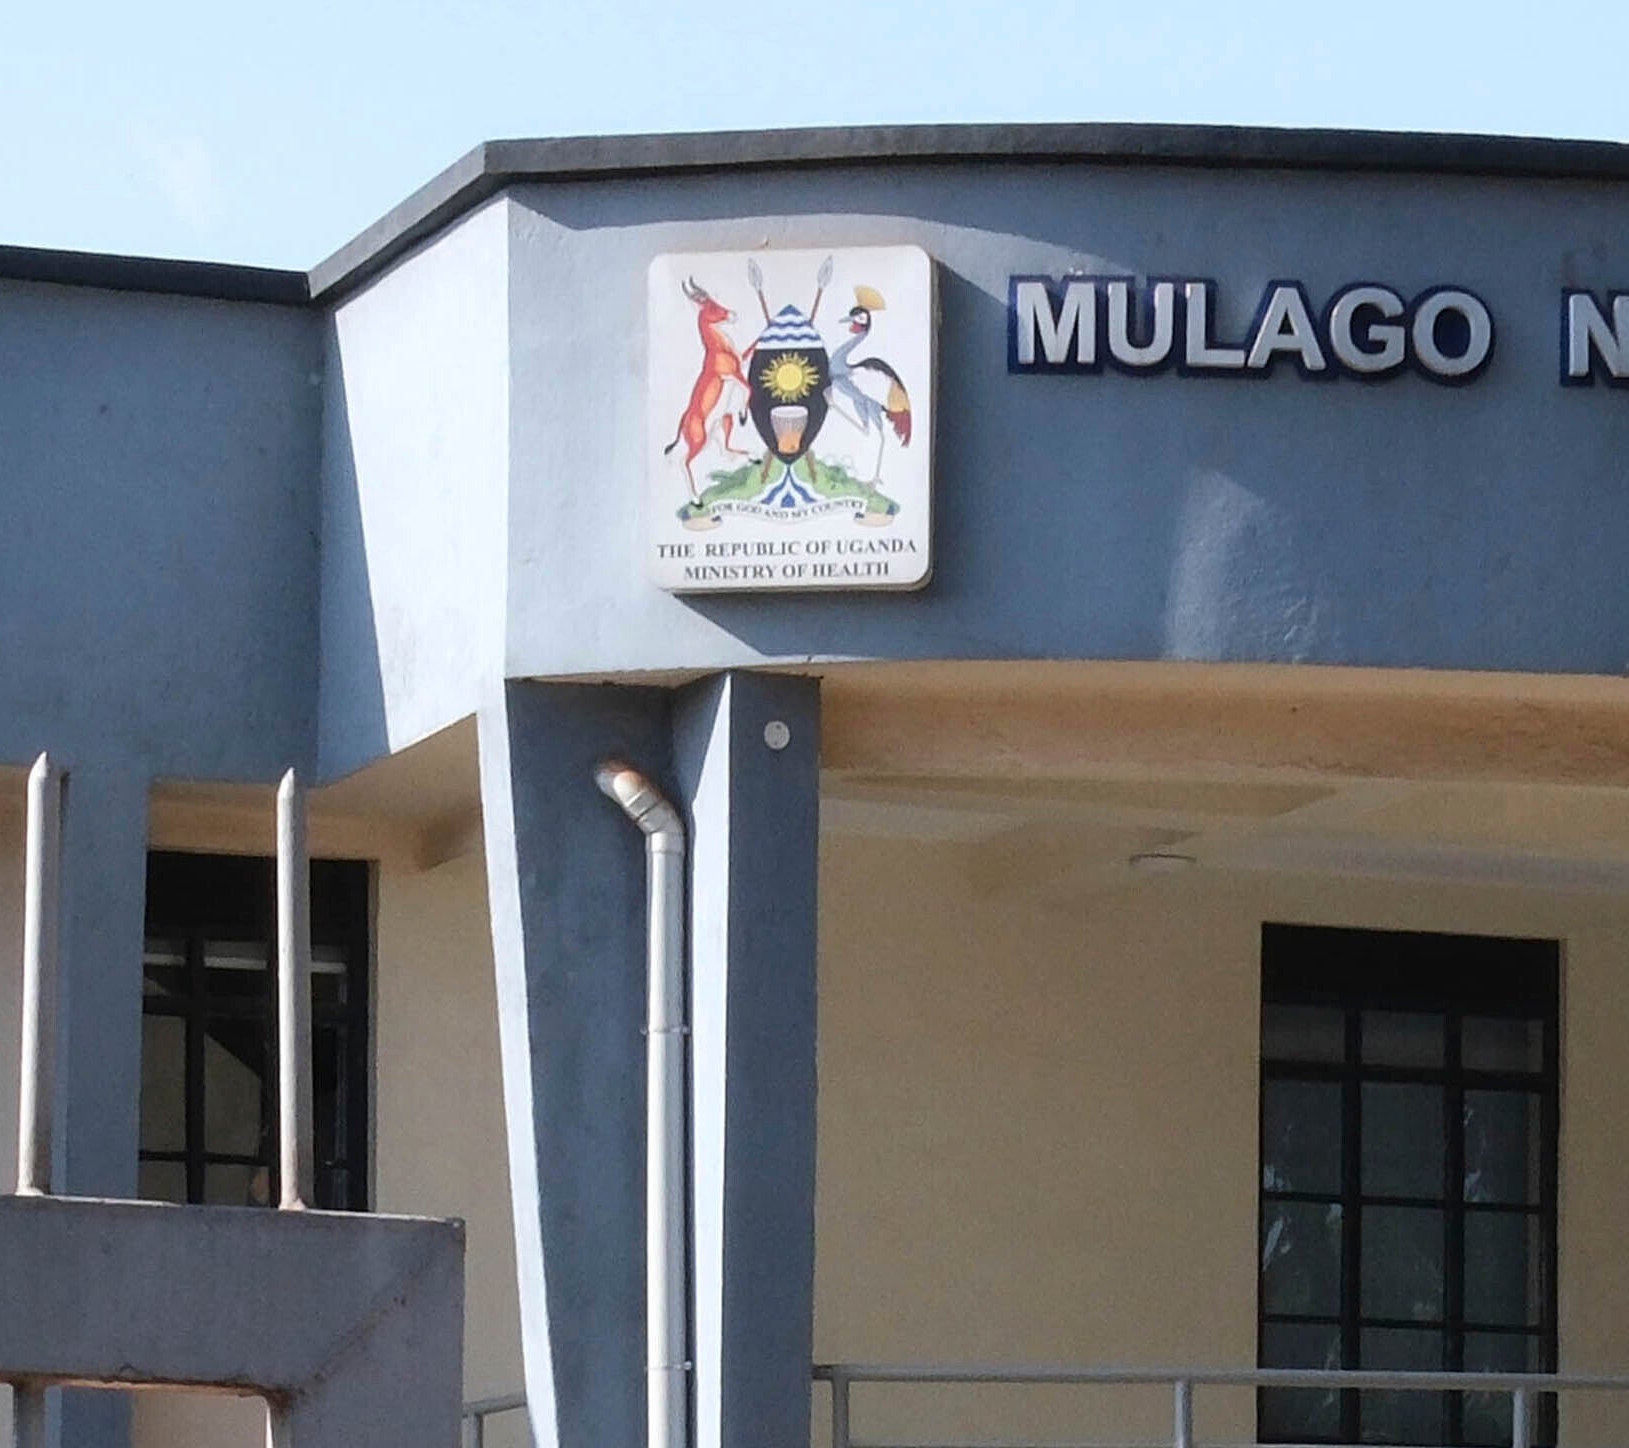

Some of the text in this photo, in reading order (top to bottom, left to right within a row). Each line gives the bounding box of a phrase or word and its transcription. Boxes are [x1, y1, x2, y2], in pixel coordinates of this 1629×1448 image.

[1014, 279, 1494, 372] MULAGO
[657, 537, 917, 558] THE REPUBLIC OF UGANDA
[683, 560, 891, 580] MINISTRY OF HEALTH
